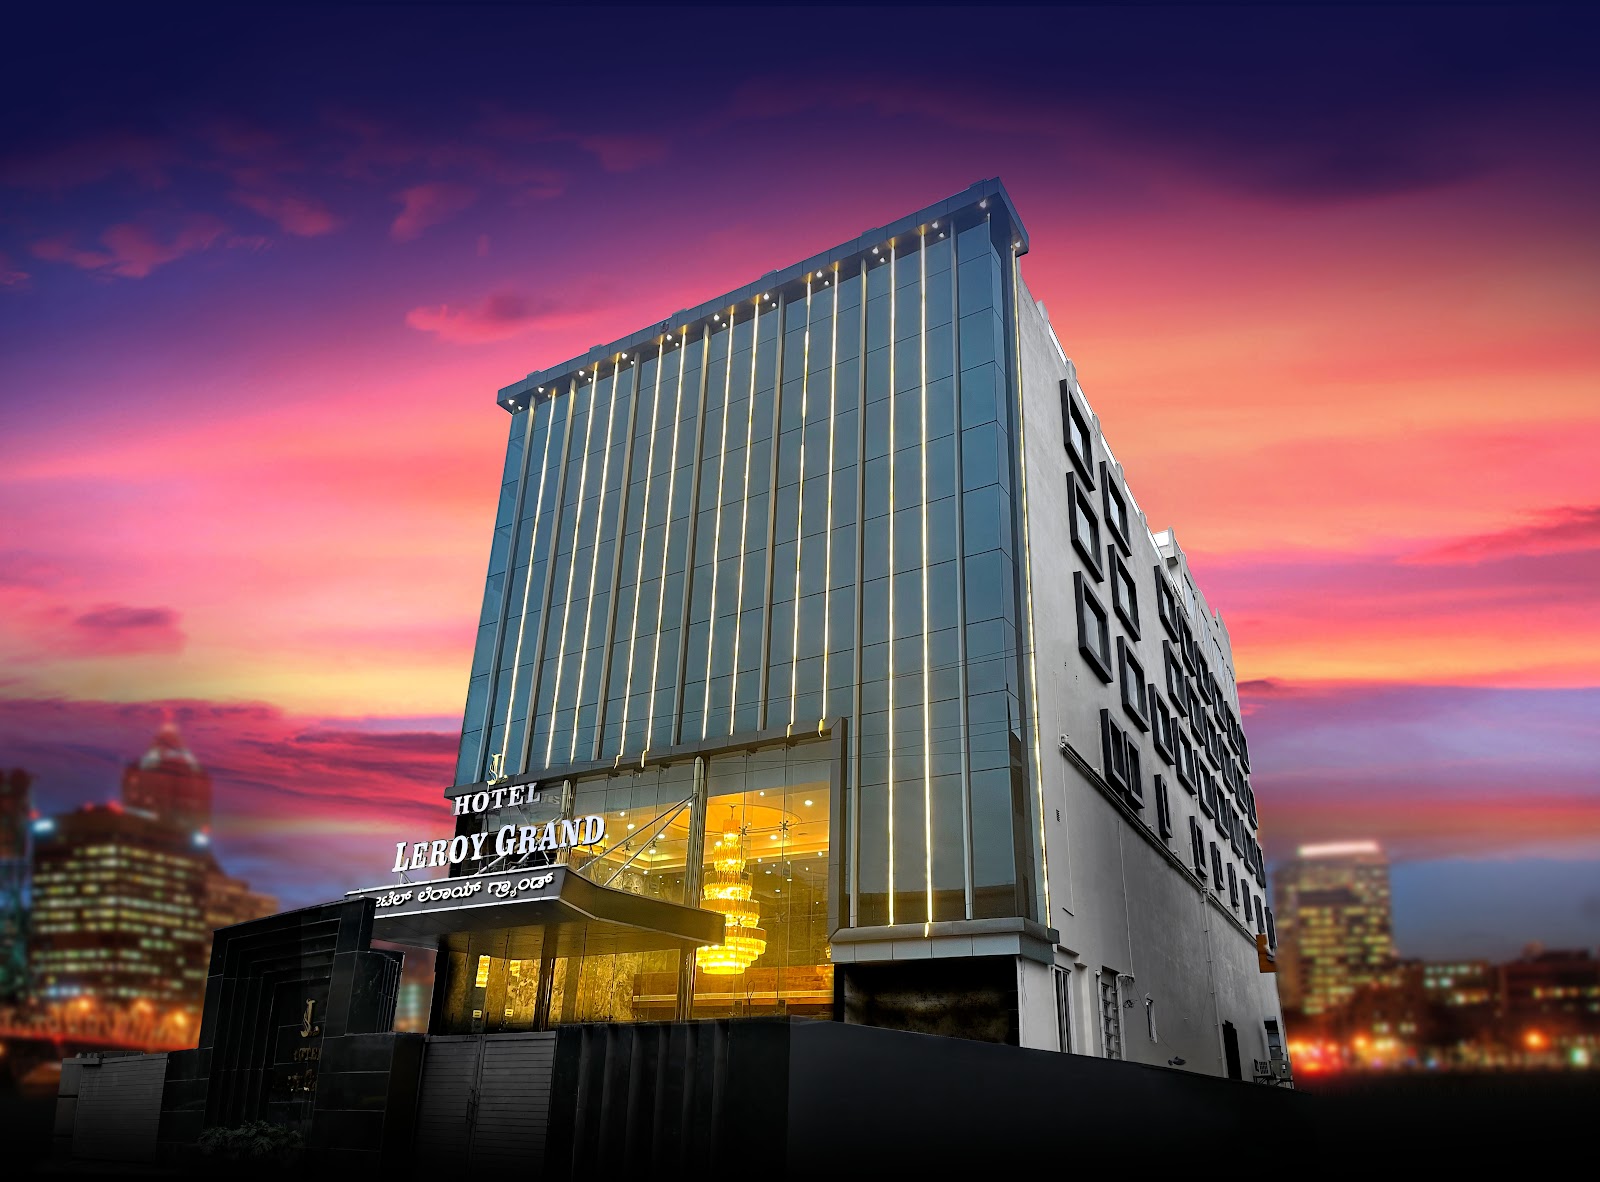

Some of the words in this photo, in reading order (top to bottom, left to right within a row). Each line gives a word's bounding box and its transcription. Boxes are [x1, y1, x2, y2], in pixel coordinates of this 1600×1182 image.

[453, 782, 541, 816] HOTEL
[392, 831, 489, 873] LEROY
[495, 815, 605, 858] GRAND
